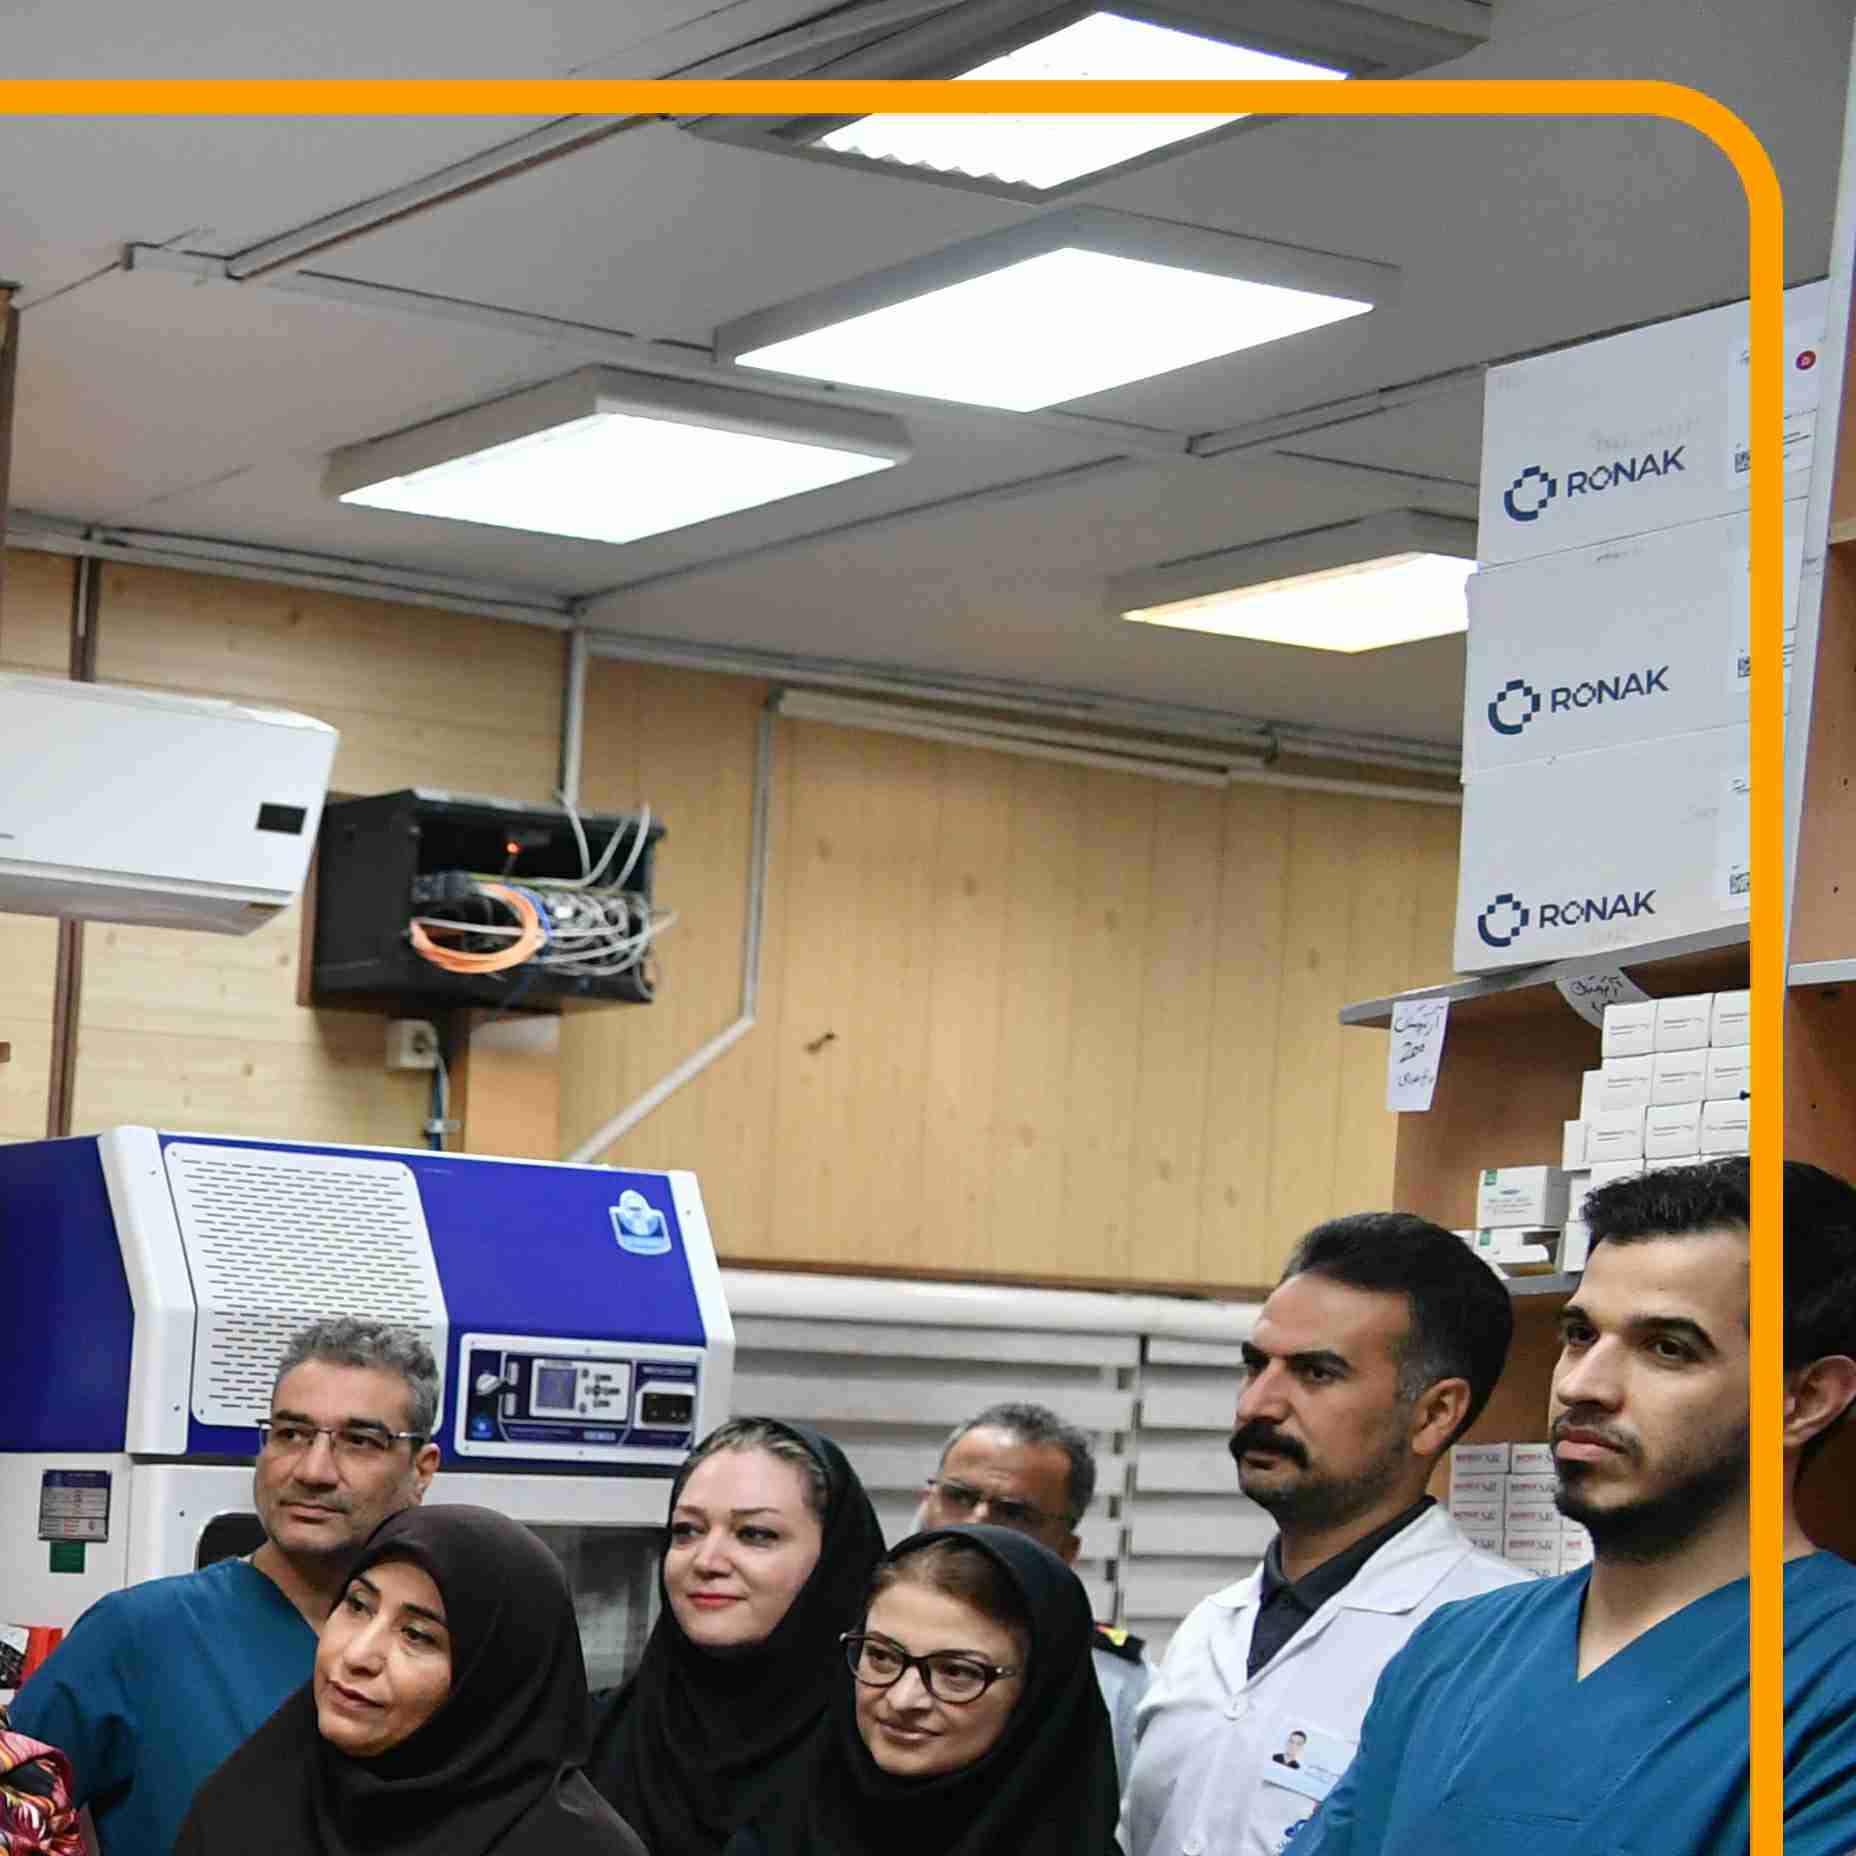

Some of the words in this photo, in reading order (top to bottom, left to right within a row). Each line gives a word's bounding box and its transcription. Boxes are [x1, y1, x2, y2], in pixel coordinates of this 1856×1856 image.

[1567, 444, 1687, 499] RONAK
[1550, 665, 1670, 714] RONAK
[1539, 889, 1657, 929] RONAK
